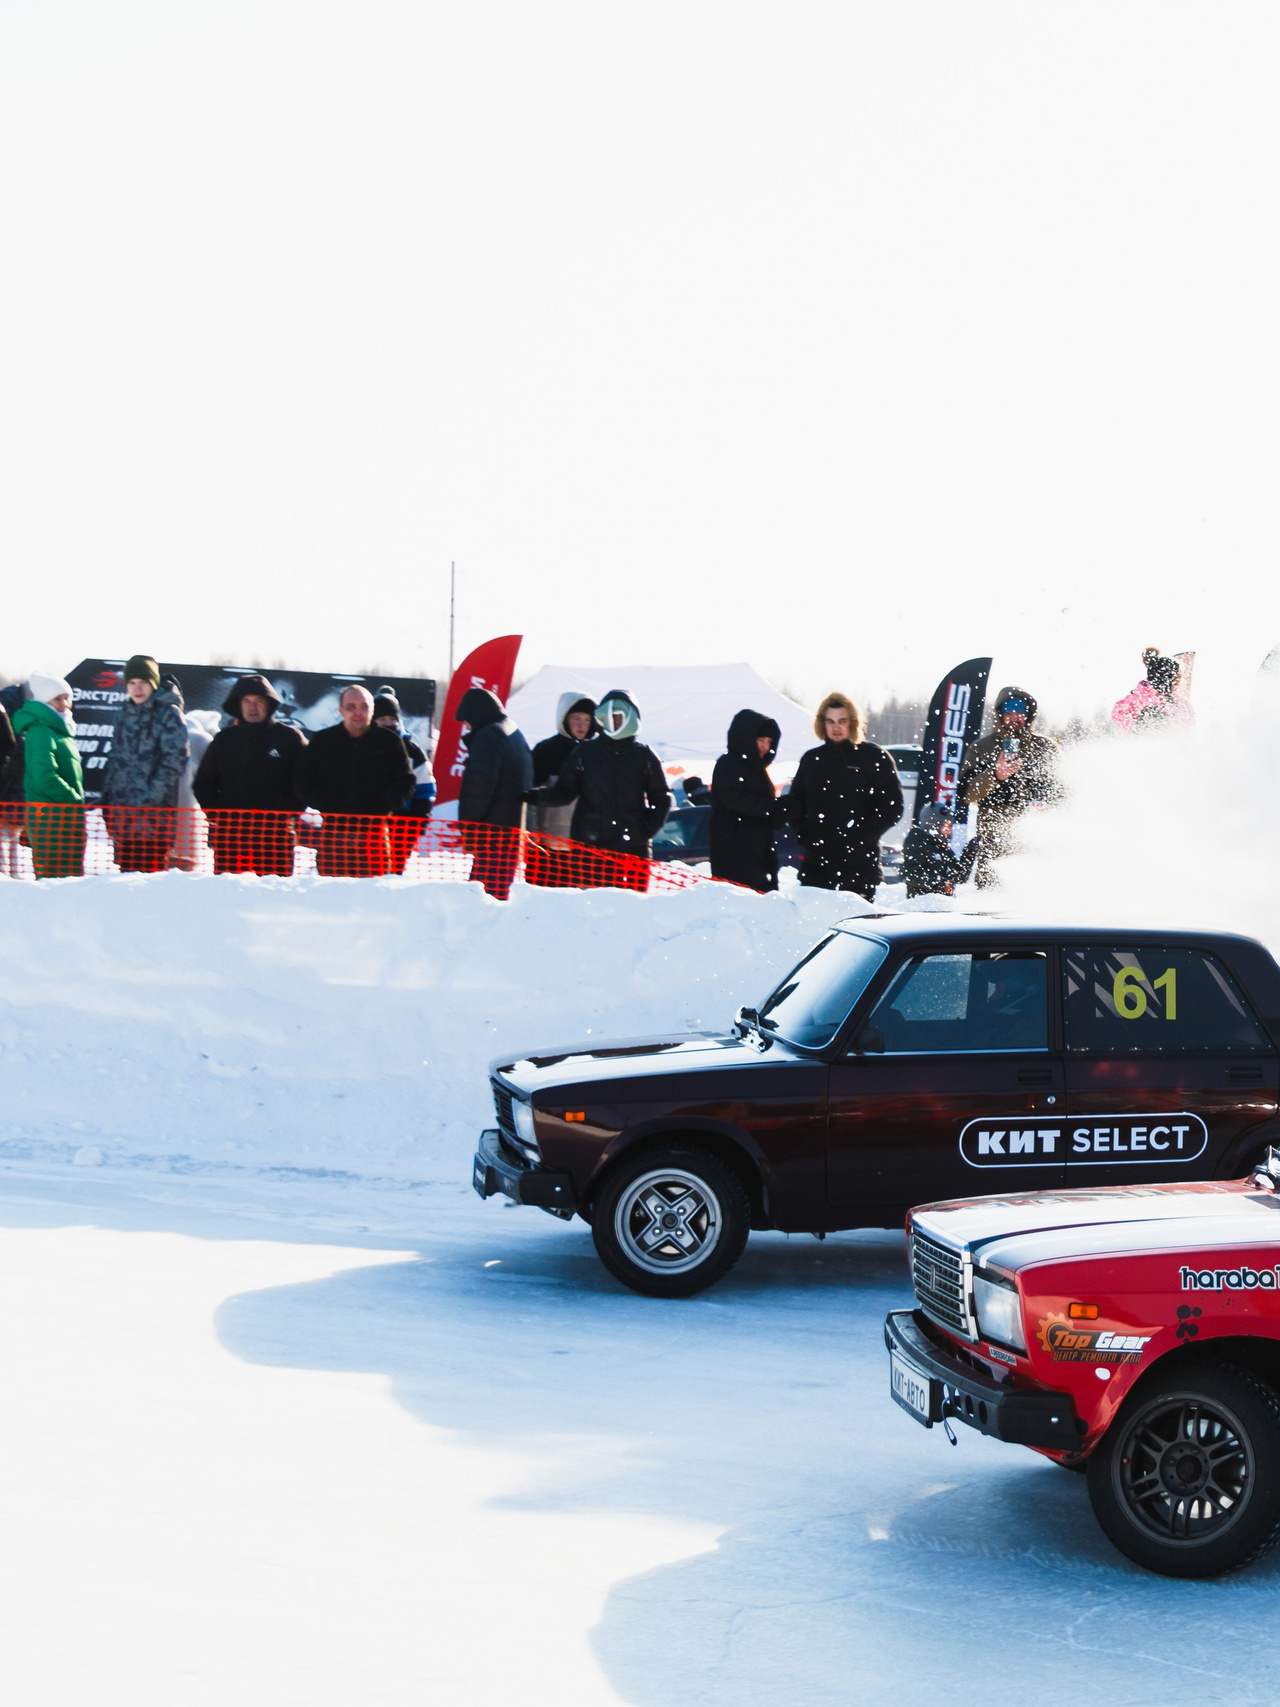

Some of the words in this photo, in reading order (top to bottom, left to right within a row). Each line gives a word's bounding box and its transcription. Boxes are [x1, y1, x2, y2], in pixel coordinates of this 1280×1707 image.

[1113, 966, 1176, 1020] 61
[978, 1130, 1060, 1154] КИТ
[1072, 1126, 1189, 1153] SELECT
[1180, 1266, 1276, 1290] haraba
[1054, 1331, 1092, 1349] Top
[1095, 1332, 1151, 1349] Gear
[1053, 1350, 1078, 1362] ЦЕНТР
[1080, 1352, 1116, 1361] РЕМОНТА
